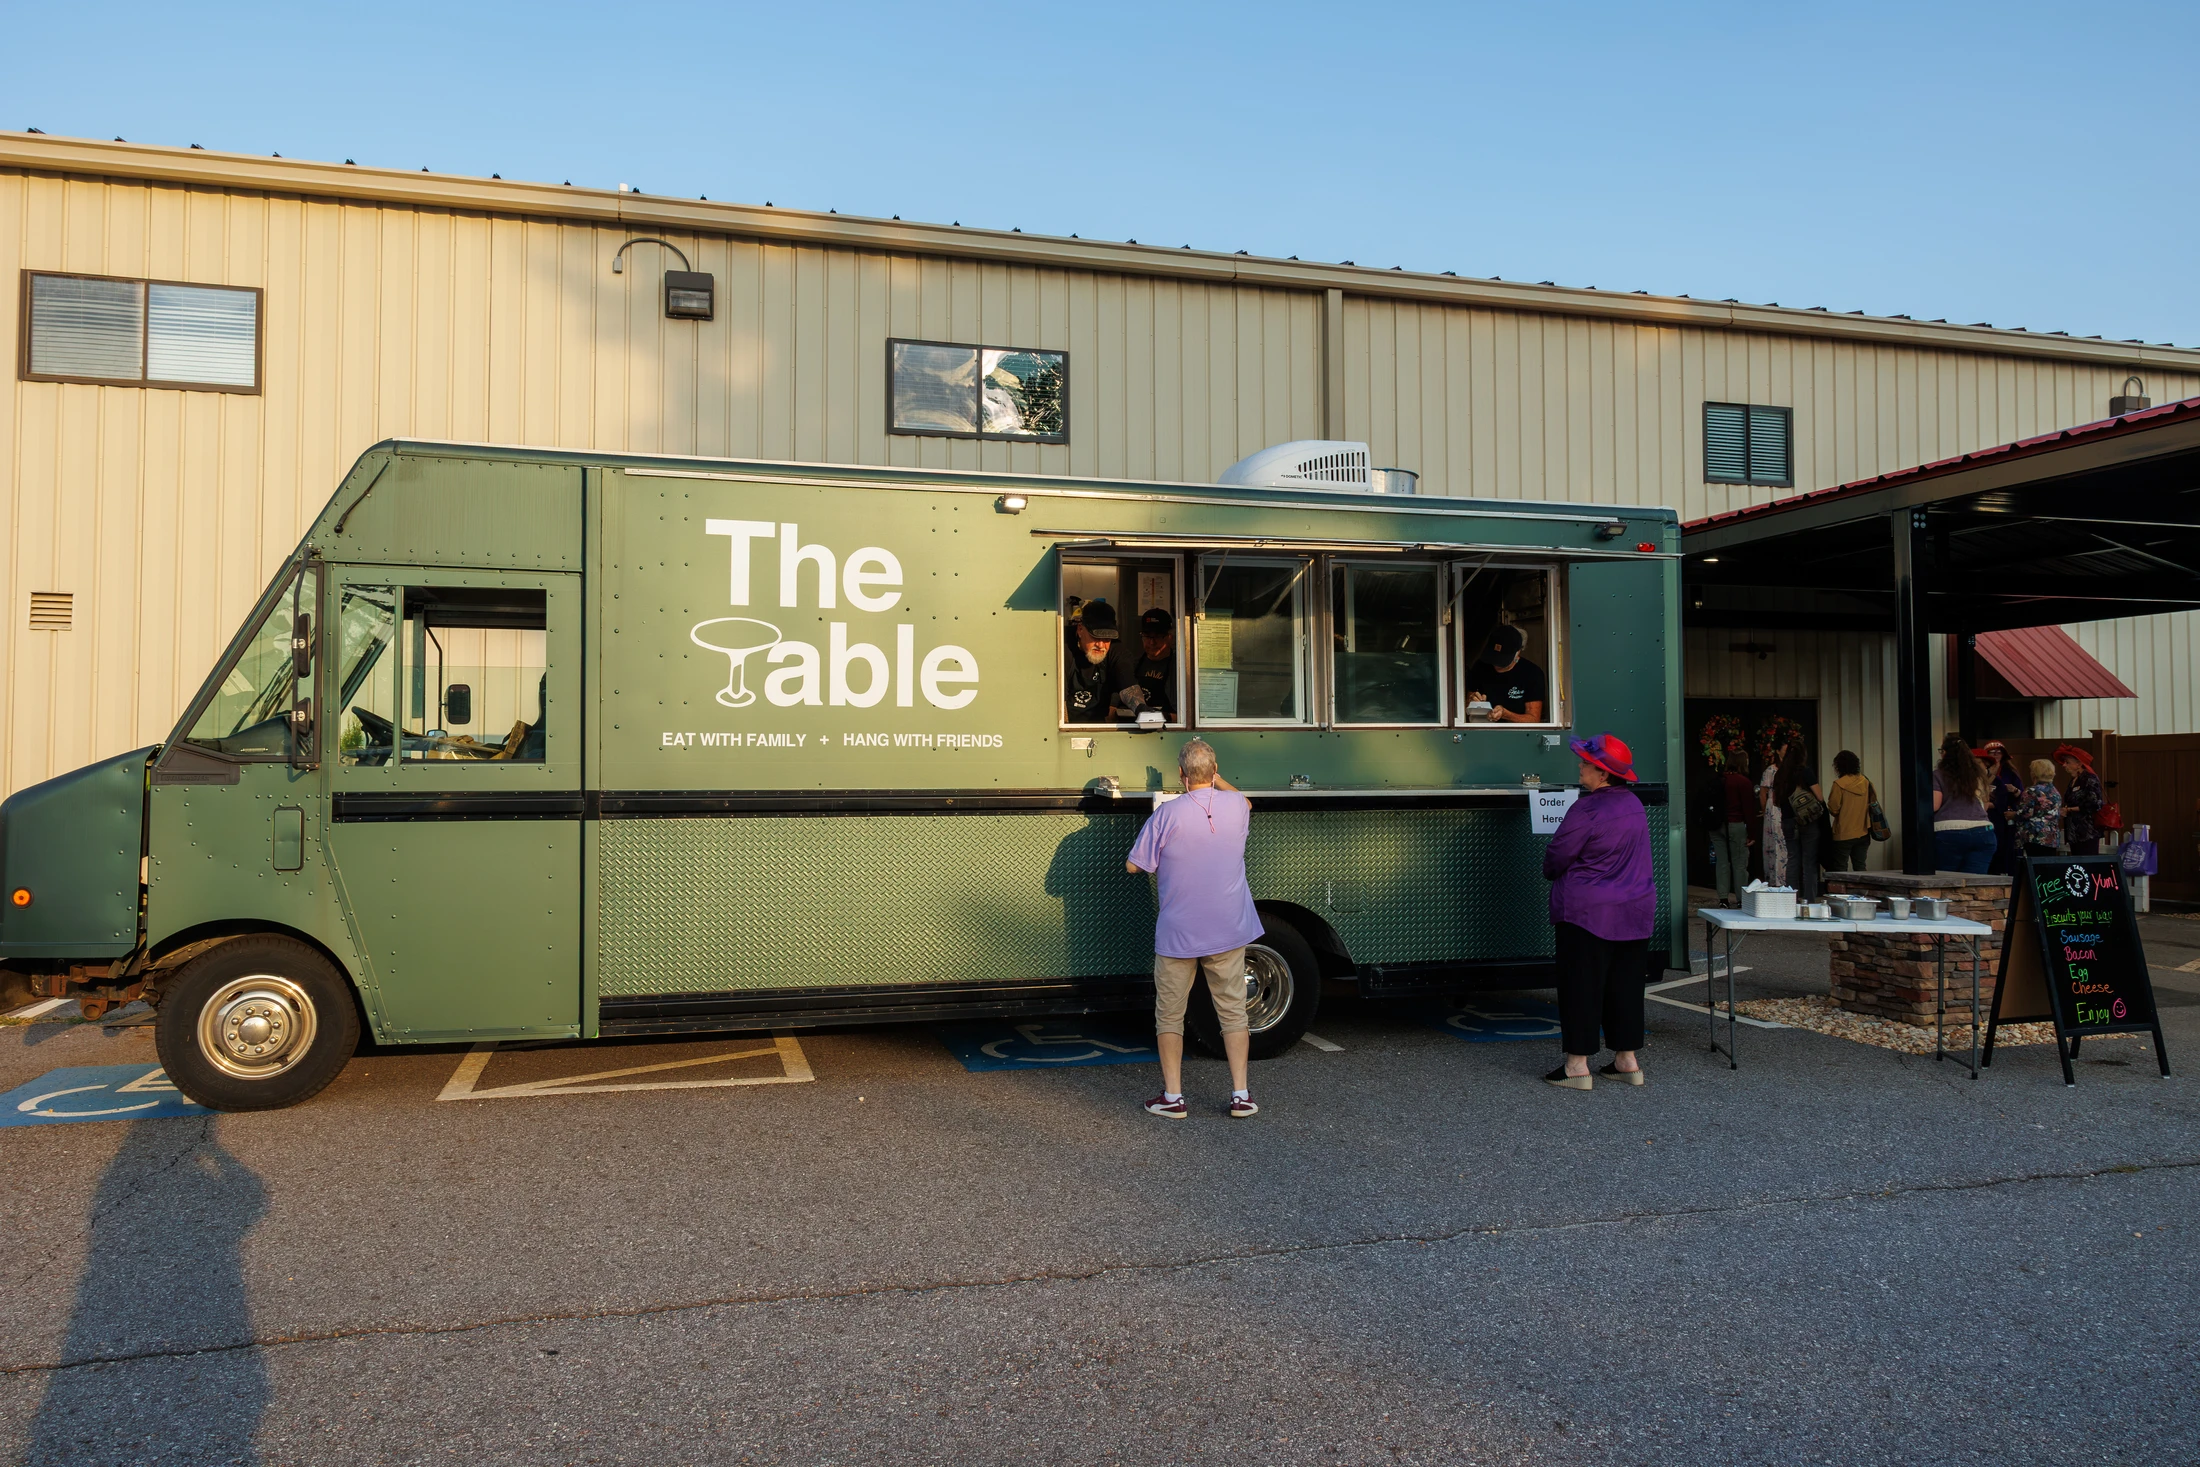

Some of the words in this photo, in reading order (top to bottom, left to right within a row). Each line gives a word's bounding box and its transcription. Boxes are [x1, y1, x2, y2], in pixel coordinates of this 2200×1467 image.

[705, 518, 903, 612] The
[662, 732, 696, 746] EAT
[700, 733, 742, 746] WITH
[746, 733, 807, 747] FAMILY
[843, 733, 889, 747] HANG
[893, 734, 932, 747] WITH
[937, 734, 1003, 747] FRIENDS
[1539, 798, 1565, 806] Order
[1542, 815, 1564, 823] Here
[2035, 874, 2064, 898] Free
[2091, 864, 2119, 900] Yum!
[2043, 908, 2077, 924] Biscuits
[2077, 910, 2092, 926] your
[2060, 929, 2104, 946] Sausage
[2064, 945, 2097, 961] Bacon
[2069, 963, 2088, 982] Egg
[2072, 981, 2114, 994] Cheese
[2076, 1002, 2110, 1024] Enjoy
